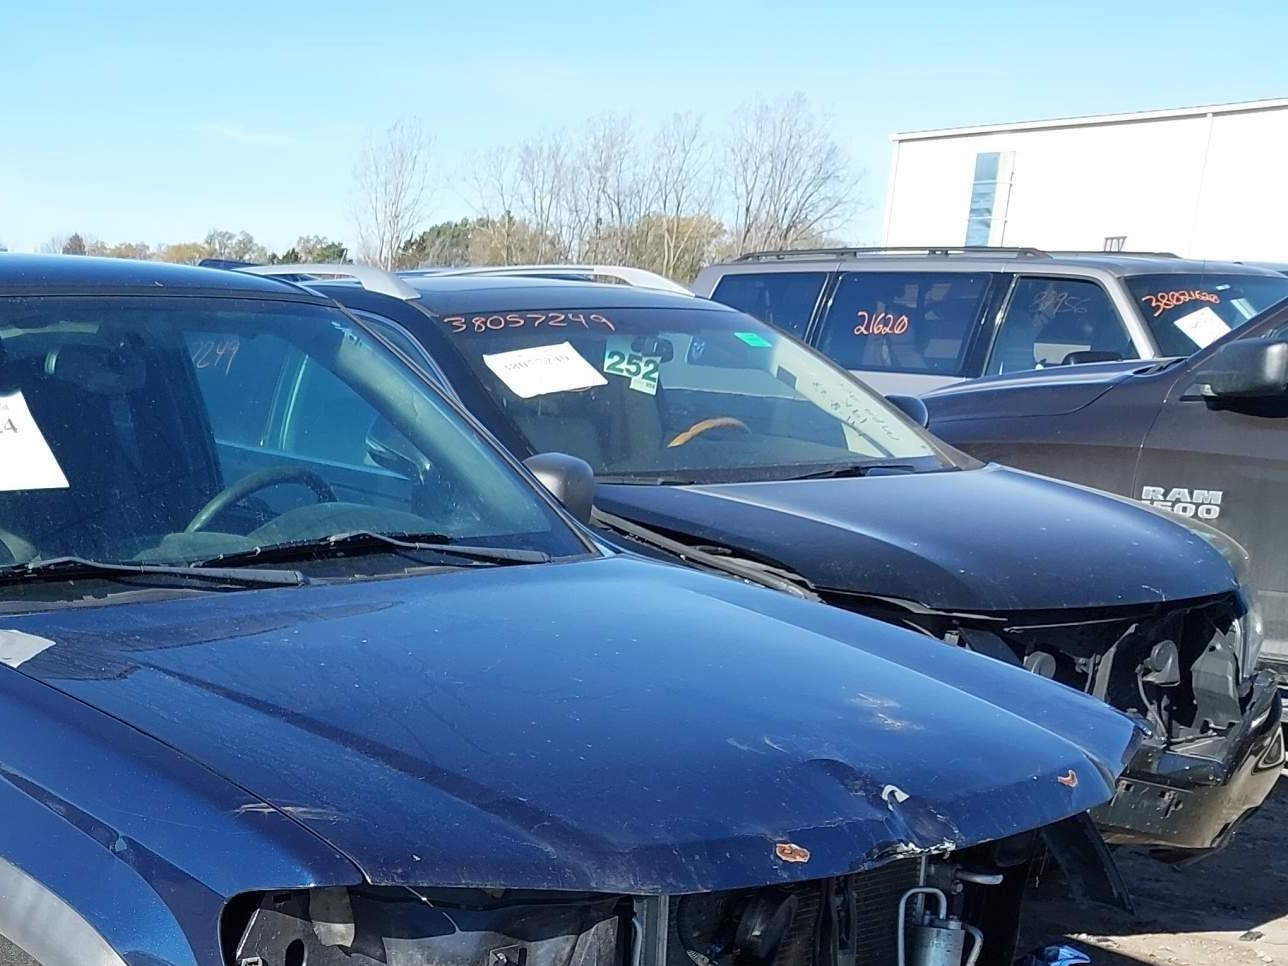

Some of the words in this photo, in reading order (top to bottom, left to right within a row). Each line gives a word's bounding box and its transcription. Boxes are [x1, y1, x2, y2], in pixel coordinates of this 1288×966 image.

[443, 312, 615, 333] 38057249
[854, 311, 909, 335] 21620
[606, 350, 659, 383] 252
[1141, 486, 1223, 505] RAM
